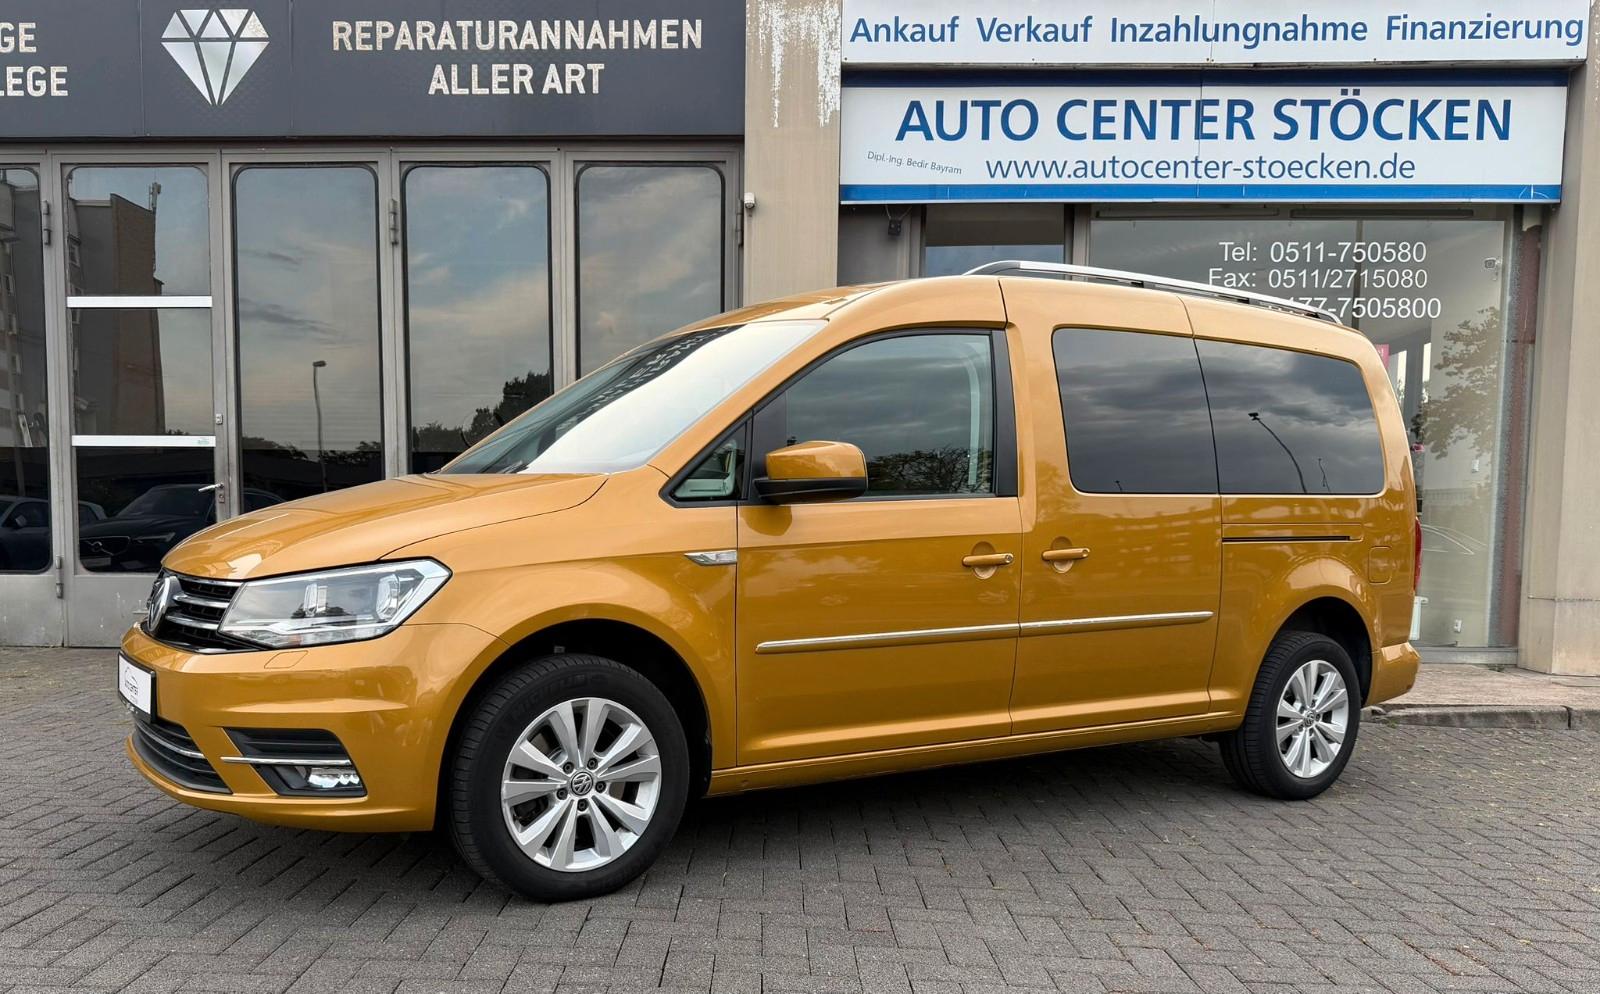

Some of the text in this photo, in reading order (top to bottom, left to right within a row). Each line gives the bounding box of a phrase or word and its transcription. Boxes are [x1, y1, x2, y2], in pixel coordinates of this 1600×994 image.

[332, 19, 702, 51] REPARATURANNAHMEN
[850, 14, 1584, 50] Ankauf Verkauf Inzahlungnahme Finanzierung
[0, 66, 69, 97] EGE
[428, 63, 605, 96] ALLER ART
[895, 88, 1512, 142] AUTO CENTER STÖCKEN
[906, 157, 929, 169] Bedir
[930, 161, 962, 175] Bayram
[985, 152, 1416, 180] www.autocenter-stoecken.de
[1218, 241, 1427, 263] Tel: 0511-750580
[1208, 267, 1428, 289] Fax: 0511/2715080
